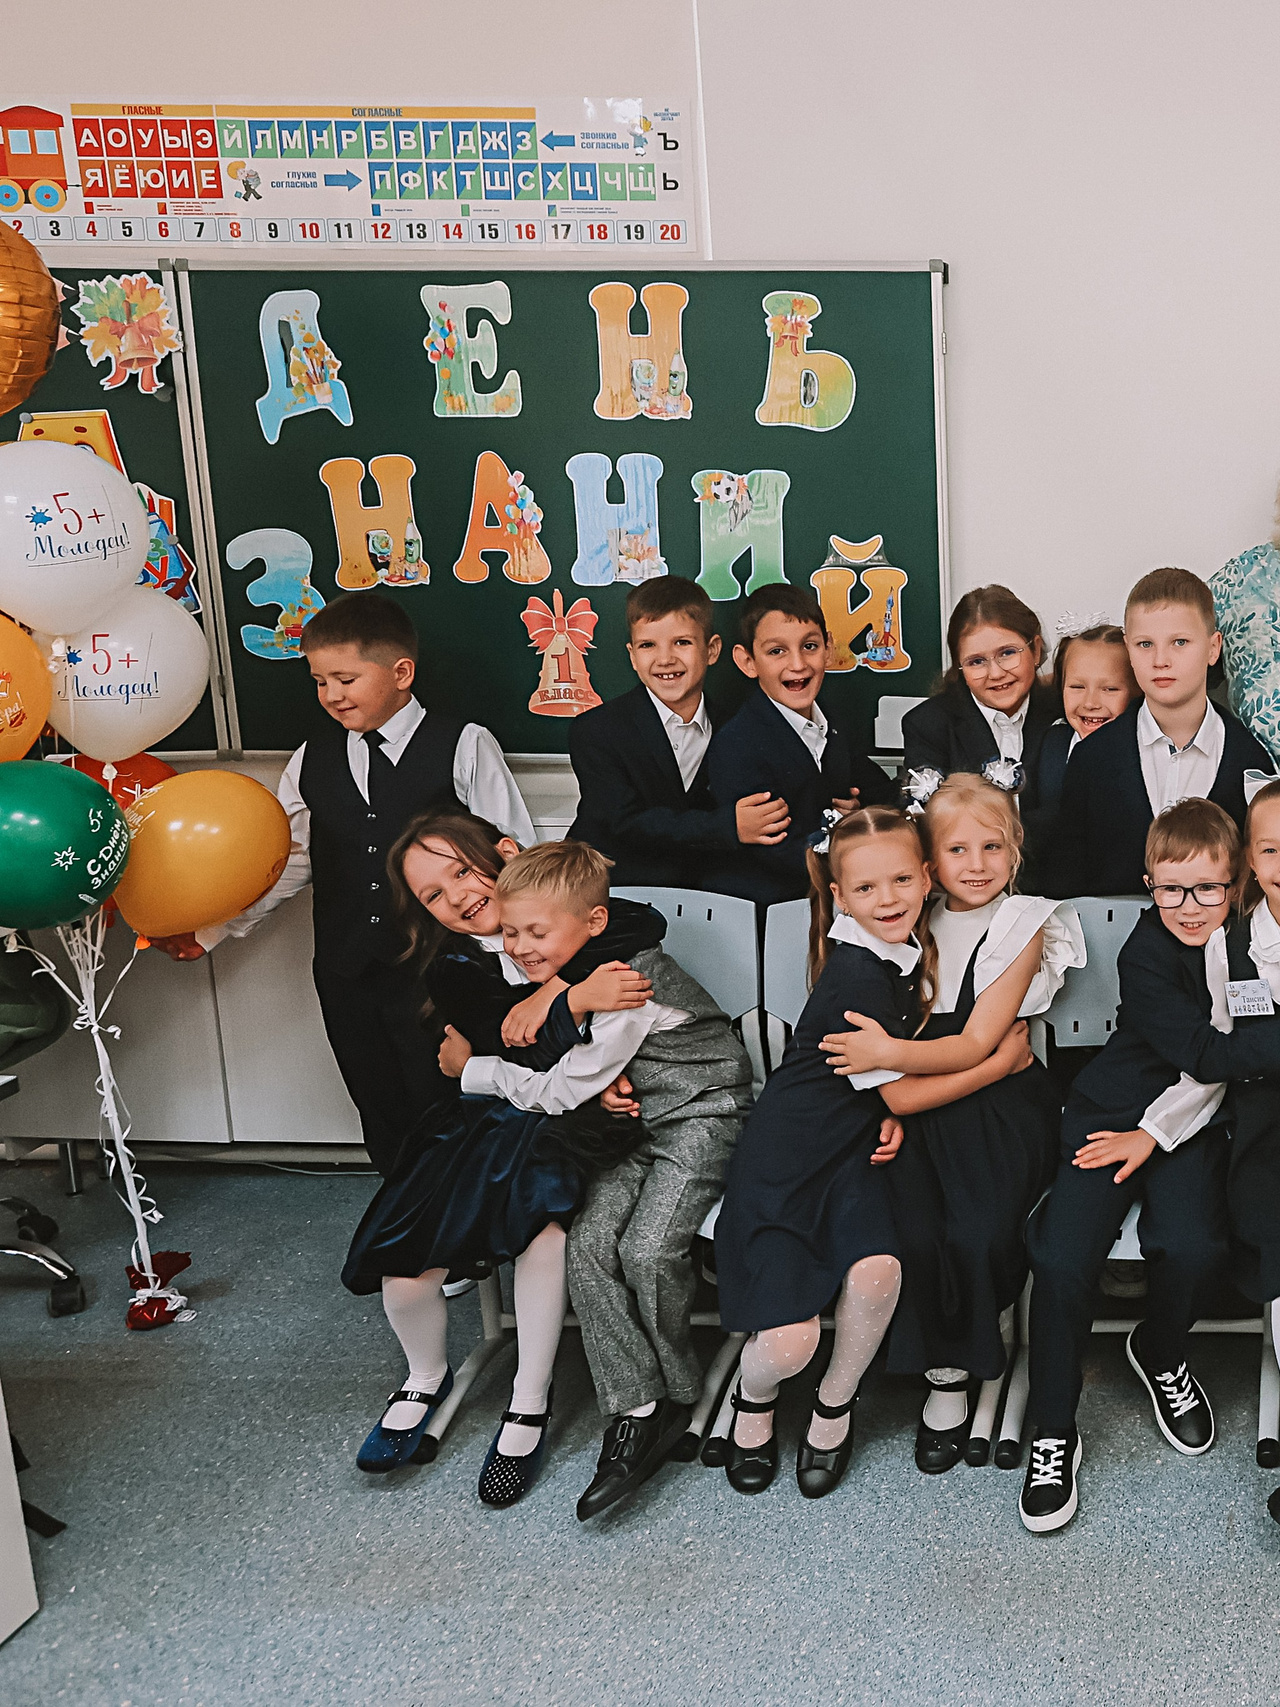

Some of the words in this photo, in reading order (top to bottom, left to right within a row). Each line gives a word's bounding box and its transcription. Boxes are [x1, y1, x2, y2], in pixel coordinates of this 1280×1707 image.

[122, 105, 163, 116] ГЛАСНЫЕ
[351, 107, 403, 118] СОГЛАСНЫЕ
[79, 128, 100, 148] А
[107, 128, 128, 149] О
[134, 128, 154, 148] У
[163, 129, 188, 148] Ы
[195, 128, 213, 149] Э
[224, 124, 243, 149] Й
[254, 130, 273, 149] Л
[282, 130, 301, 149] М
[311, 130, 329, 149] Н
[341, 130, 359, 149] Р
[370, 130, 390, 150] Б
[399, 131, 418, 150] В
[429, 131, 444, 150] Г
[456, 131, 477, 154] Д
[482, 130, 507, 150] Ж
[517, 130, 532, 150] З
[657, 132, 679, 150] Ъ
[84, 168, 105, 188] Я
[115, 164, 131, 188] Ё
[140, 168, 165, 188] Ю
[171, 169, 190, 188] И
[202, 169, 218, 188] Е
[373, 171, 393, 190] П
[400, 170, 422, 191] Ф
[432, 171, 449, 190] К
[459, 171, 475, 190] Т
[484, 171, 510, 190] Ш
[517, 171, 536, 191] С
[546, 171, 567, 190] Х
[574, 172, 593, 195] Ц
[604, 172, 621, 190] Ч
[629, 172, 655, 195] Щ
[663, 173, 679, 190] Ь
[12, 221, 23, 236] 2
[50, 220, 61, 237] 3
[86, 220, 97, 237] 4
[122, 221, 133, 237] 5
[158, 221, 169, 237] 6
[194, 221, 205, 237] 7
[230, 222, 242, 238] 8
[267, 222, 278, 238] 9
[299, 222, 320, 238] 10
[334, 222, 353, 238] 11
[371, 223, 392, 240] 12
[406, 223, 427, 239] 13
[442, 223, 463, 239] 14
[478, 223, 499, 240] 15
[515, 223, 536, 240] 16
[551, 223, 570, 240] 17
[587, 224, 608, 240] 18
[624, 224, 645, 241] 19
[660, 224, 681, 241] 20
[26, 522, 130, 561] Молодец!
[551, 647, 577, 683] 1
[538, 687, 593, 702] класс
